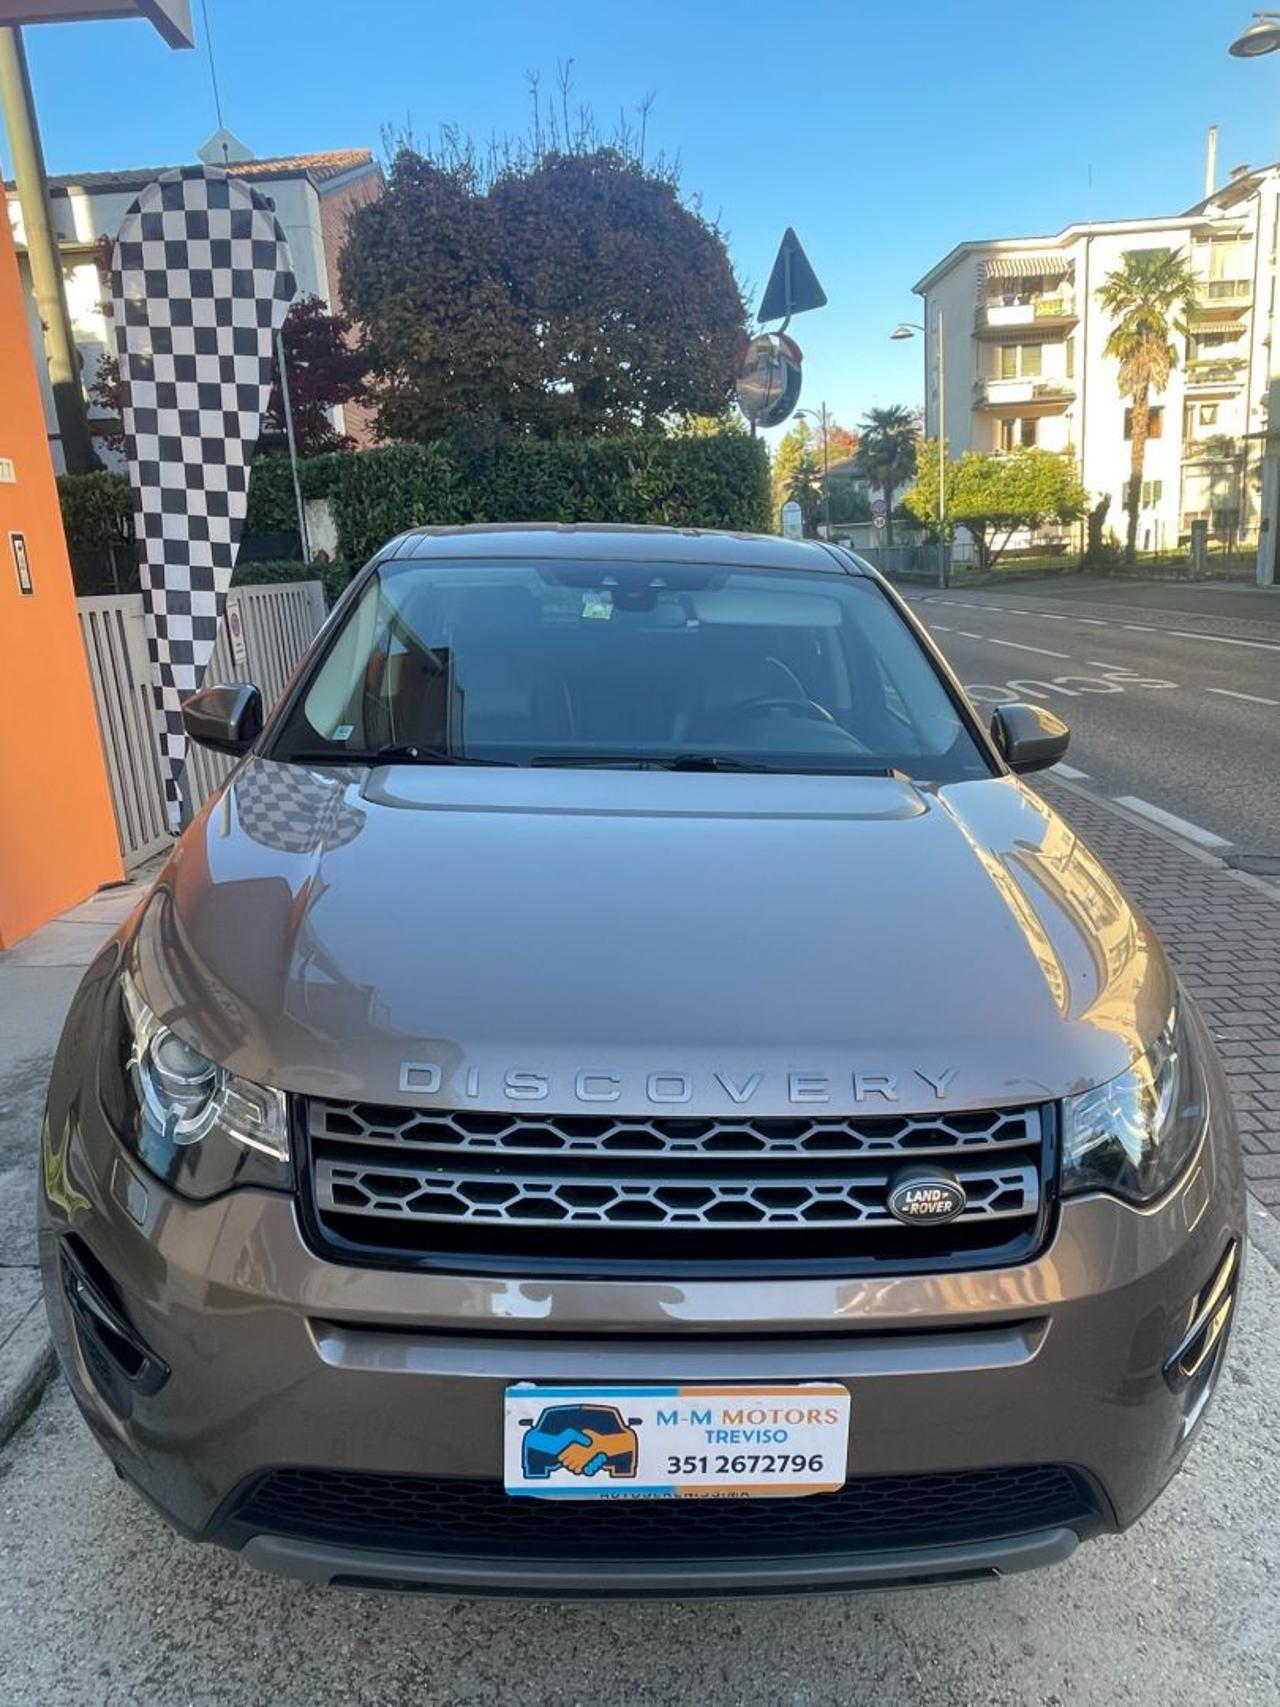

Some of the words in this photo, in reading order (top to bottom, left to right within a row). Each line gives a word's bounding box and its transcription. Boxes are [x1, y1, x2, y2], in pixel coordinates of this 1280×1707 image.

[398, 1061, 958, 1104] DISCOVERY
[905, 1189, 942, 1203] LAND
[909, 1201, 952, 1214] ROVER
[656, 1409, 712, 1425] M-M
[722, 1409, 839, 1425] MOTORS
[705, 1429, 788, 1444] TREVISO
